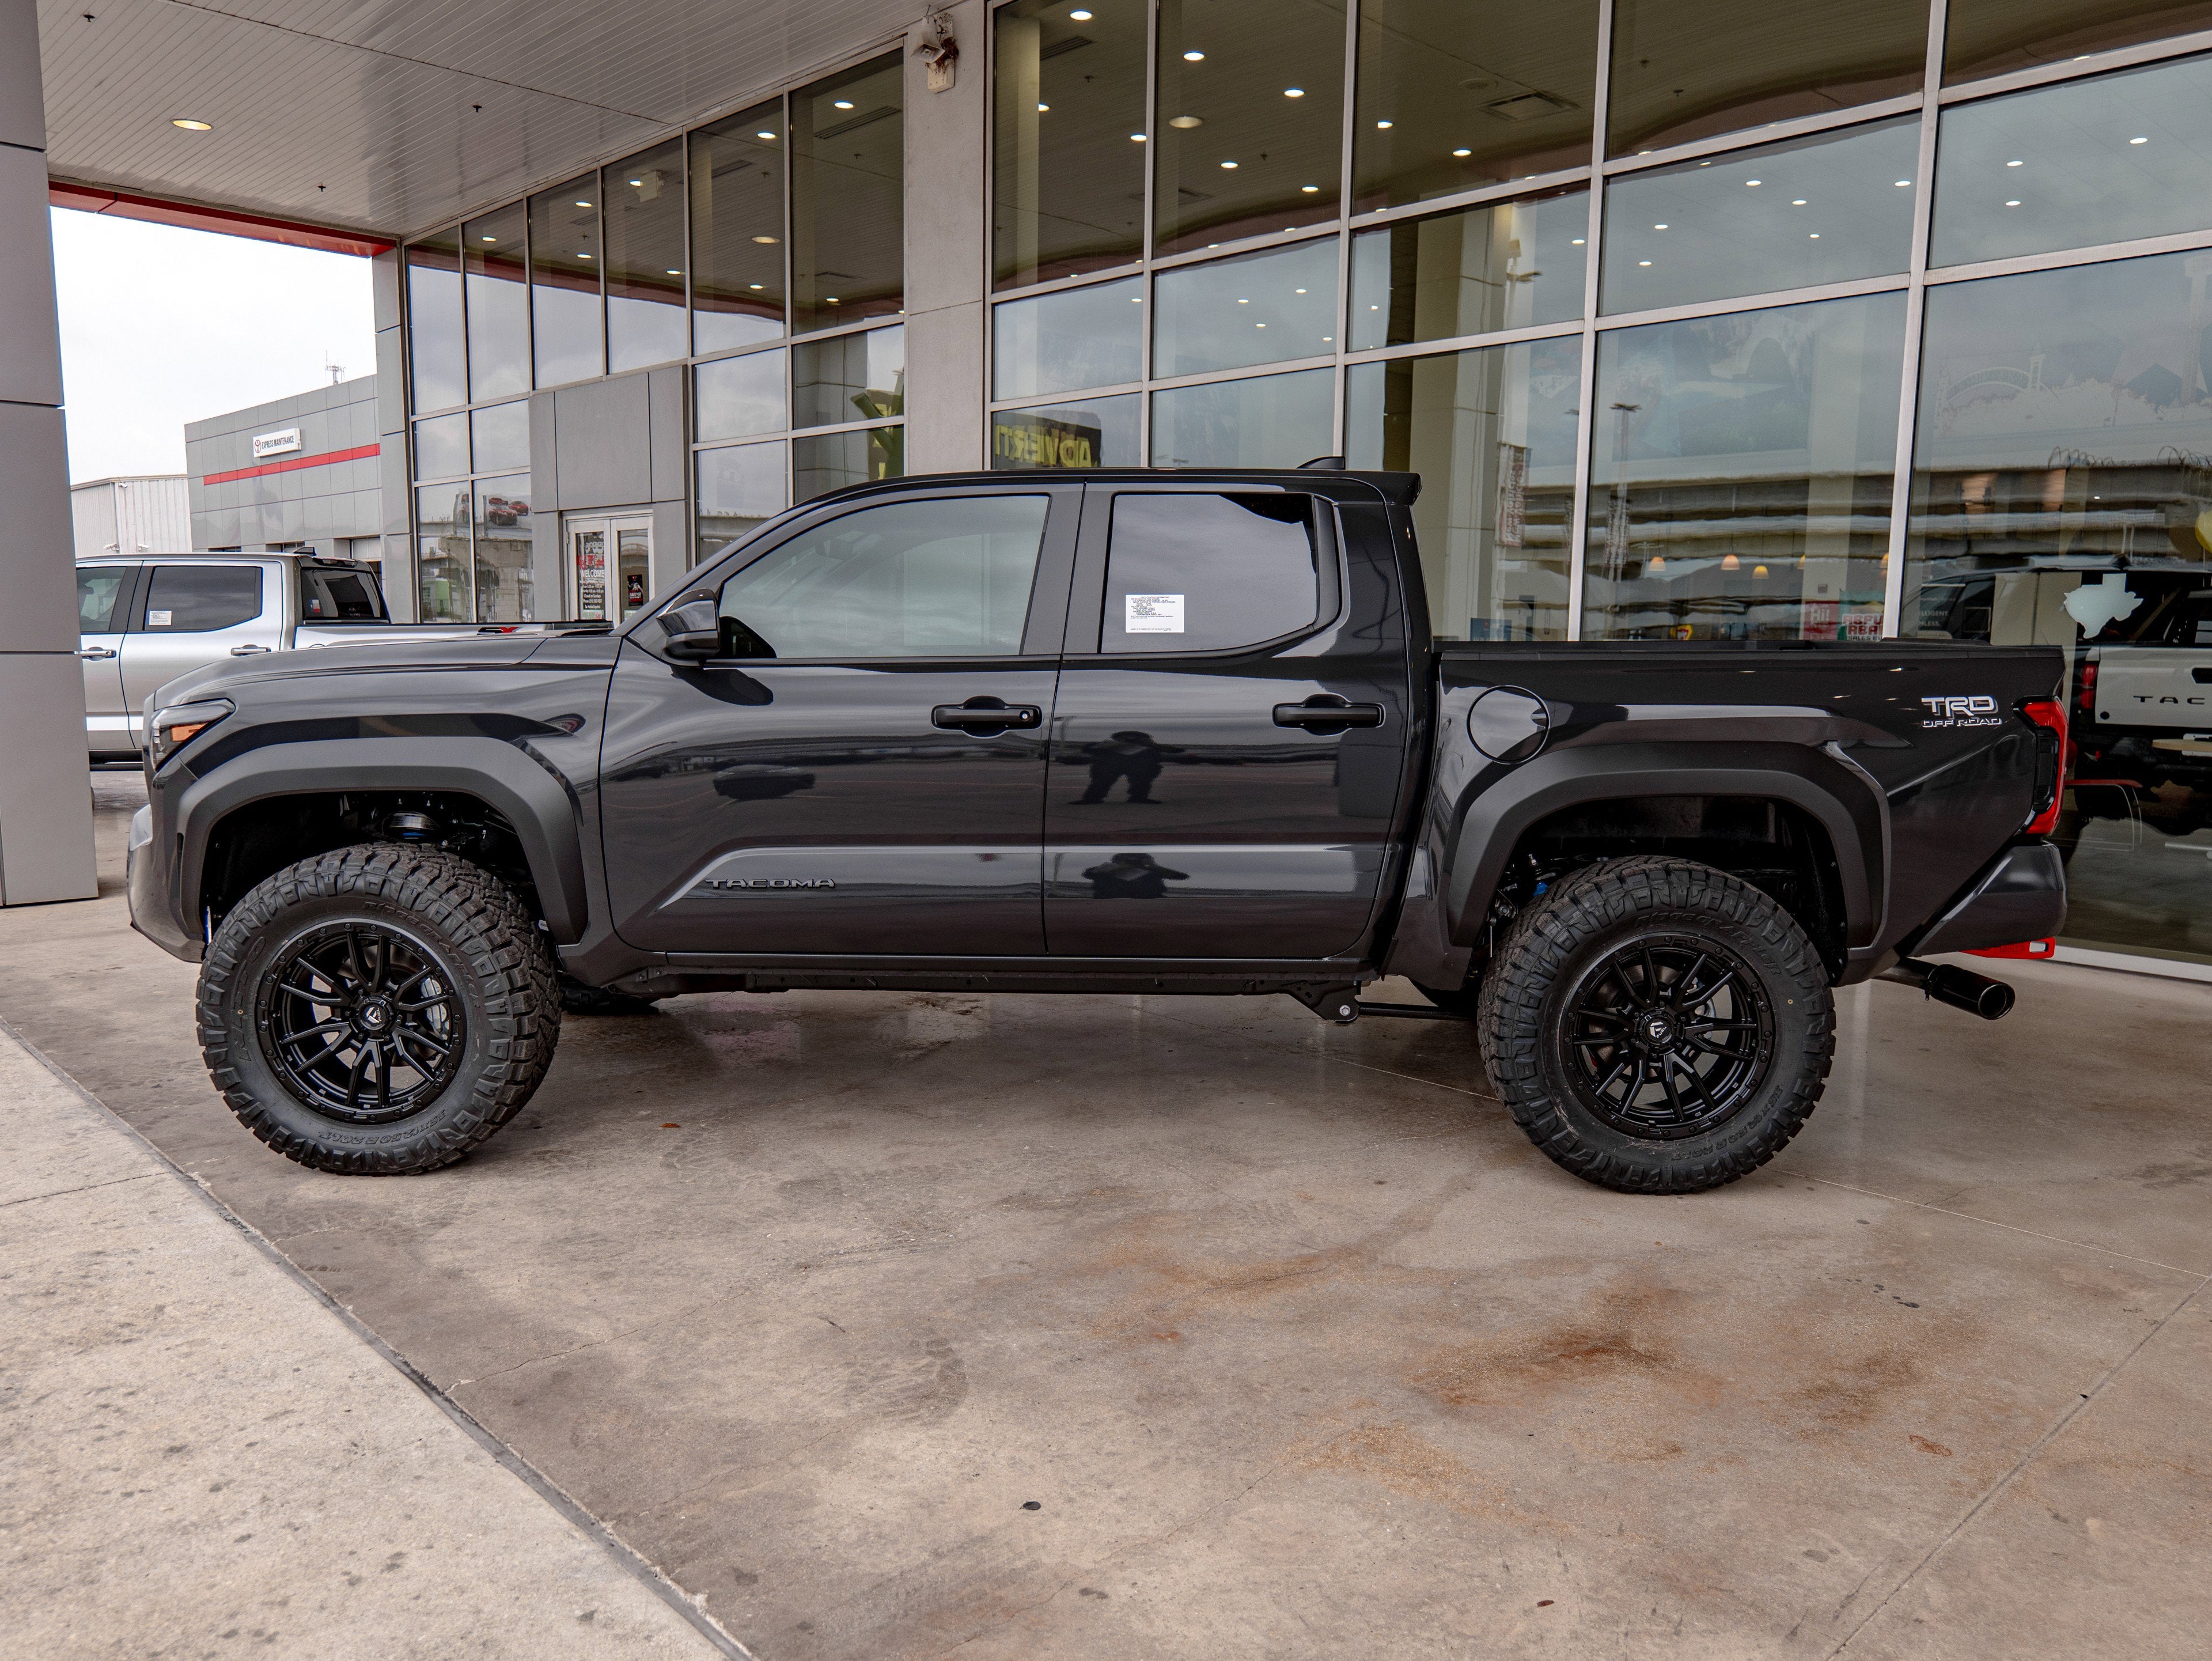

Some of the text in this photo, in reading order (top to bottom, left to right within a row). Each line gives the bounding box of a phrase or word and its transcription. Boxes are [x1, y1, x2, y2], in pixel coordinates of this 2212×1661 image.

[262, 435, 294, 449] EXPRESS MAINTENANCE
[2133, 695, 2205, 705] TAC
[1921, 695, 1995, 717] TRD
[1922, 718, 2002, 728] OFF ROAD
[705, 878, 836, 888] TACOMA
